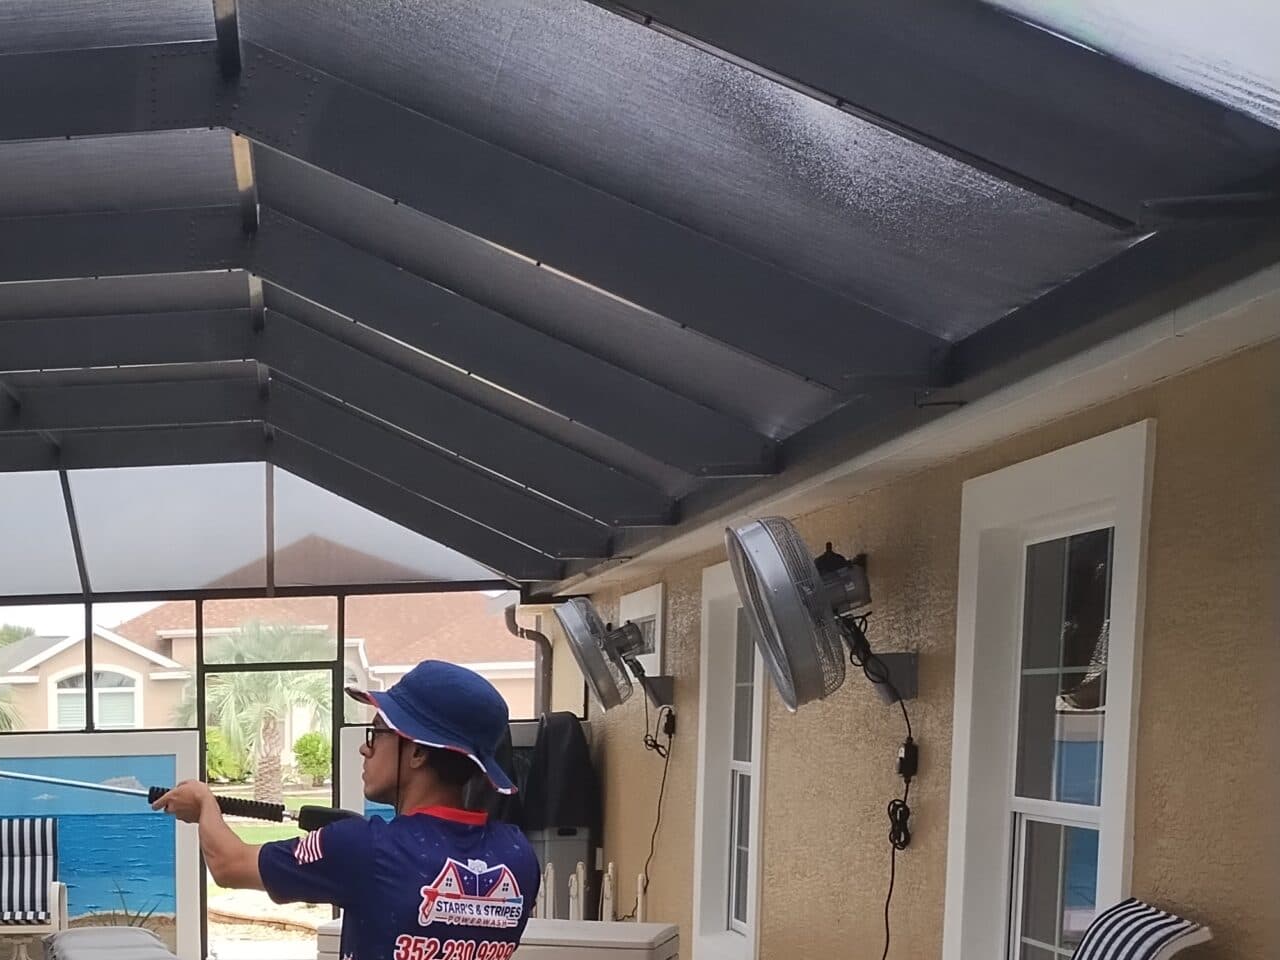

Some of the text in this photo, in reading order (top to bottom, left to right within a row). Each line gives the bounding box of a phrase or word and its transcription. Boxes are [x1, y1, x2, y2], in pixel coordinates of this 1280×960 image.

[436, 900, 521, 918] STARR'S & STRIPES
